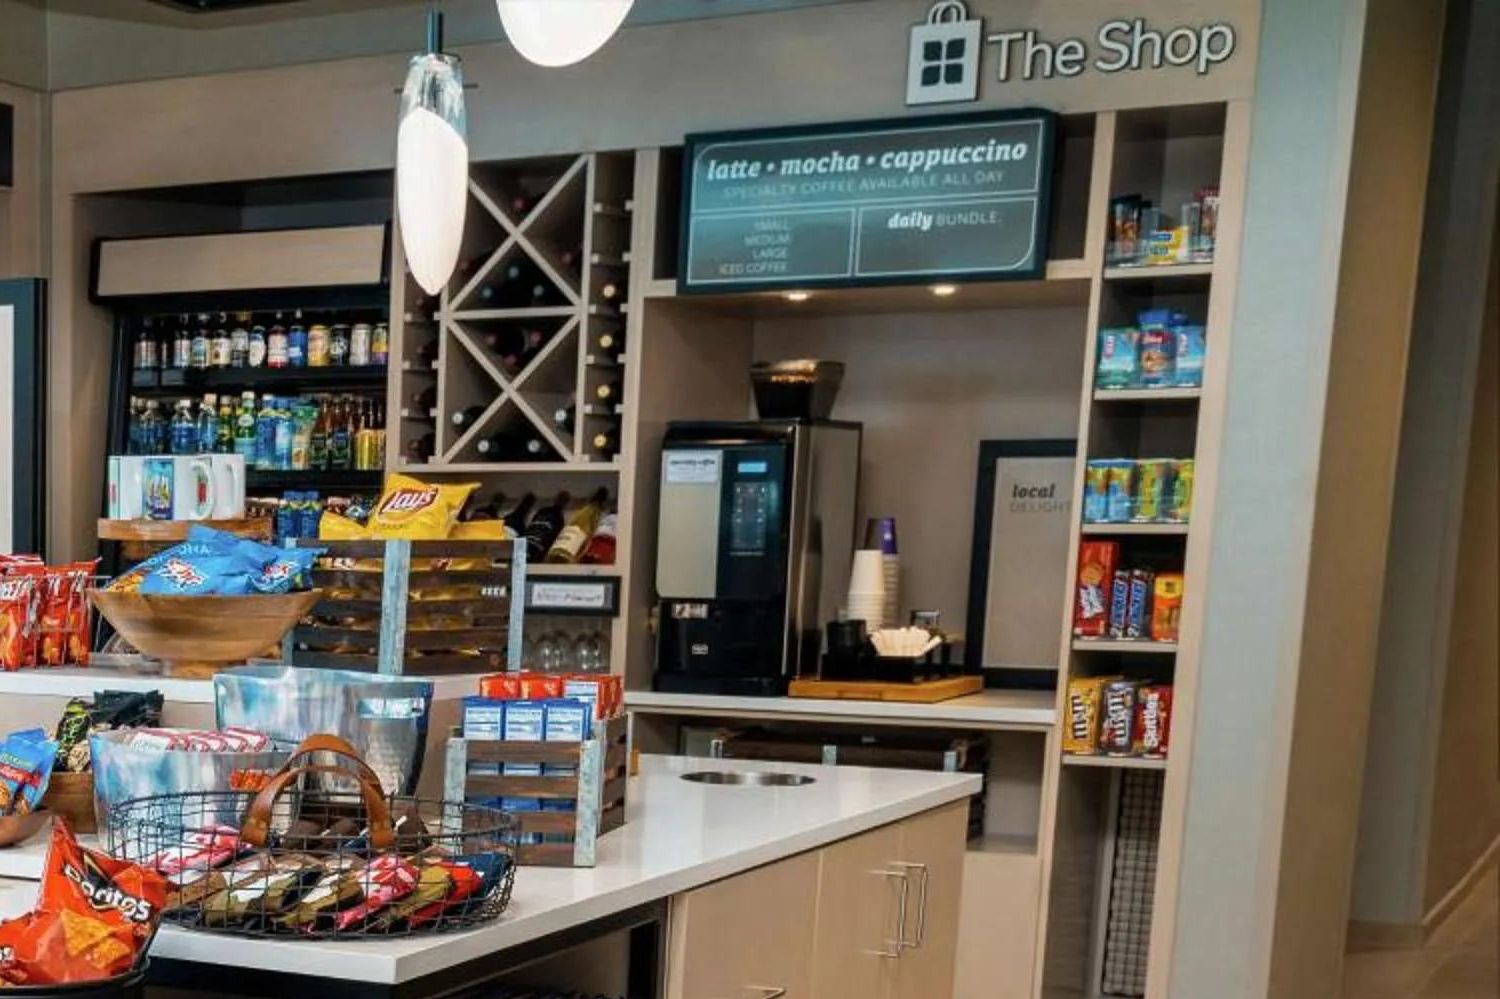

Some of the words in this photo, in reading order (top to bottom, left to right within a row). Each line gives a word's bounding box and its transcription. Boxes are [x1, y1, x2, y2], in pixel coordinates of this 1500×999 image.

[987, 31, 1086, 82] The
[1095, 18, 1235, 75] Shop
[707, 158, 761, 181] latte
[780, 151, 860, 176] mocha
[880, 138, 1028, 173] cappuccino
[801, 180, 854, 195] COFFEE
[859, 175, 939, 191] AVAILABLE
[943, 172, 971, 186] ALL
[974, 170, 1005, 184] DAY
[887, 210, 934, 231] daily
[935, 211, 998, 227] BUNDLE
[1012, 483, 1056, 499] local
[64, 863, 152, 921] Doritos
